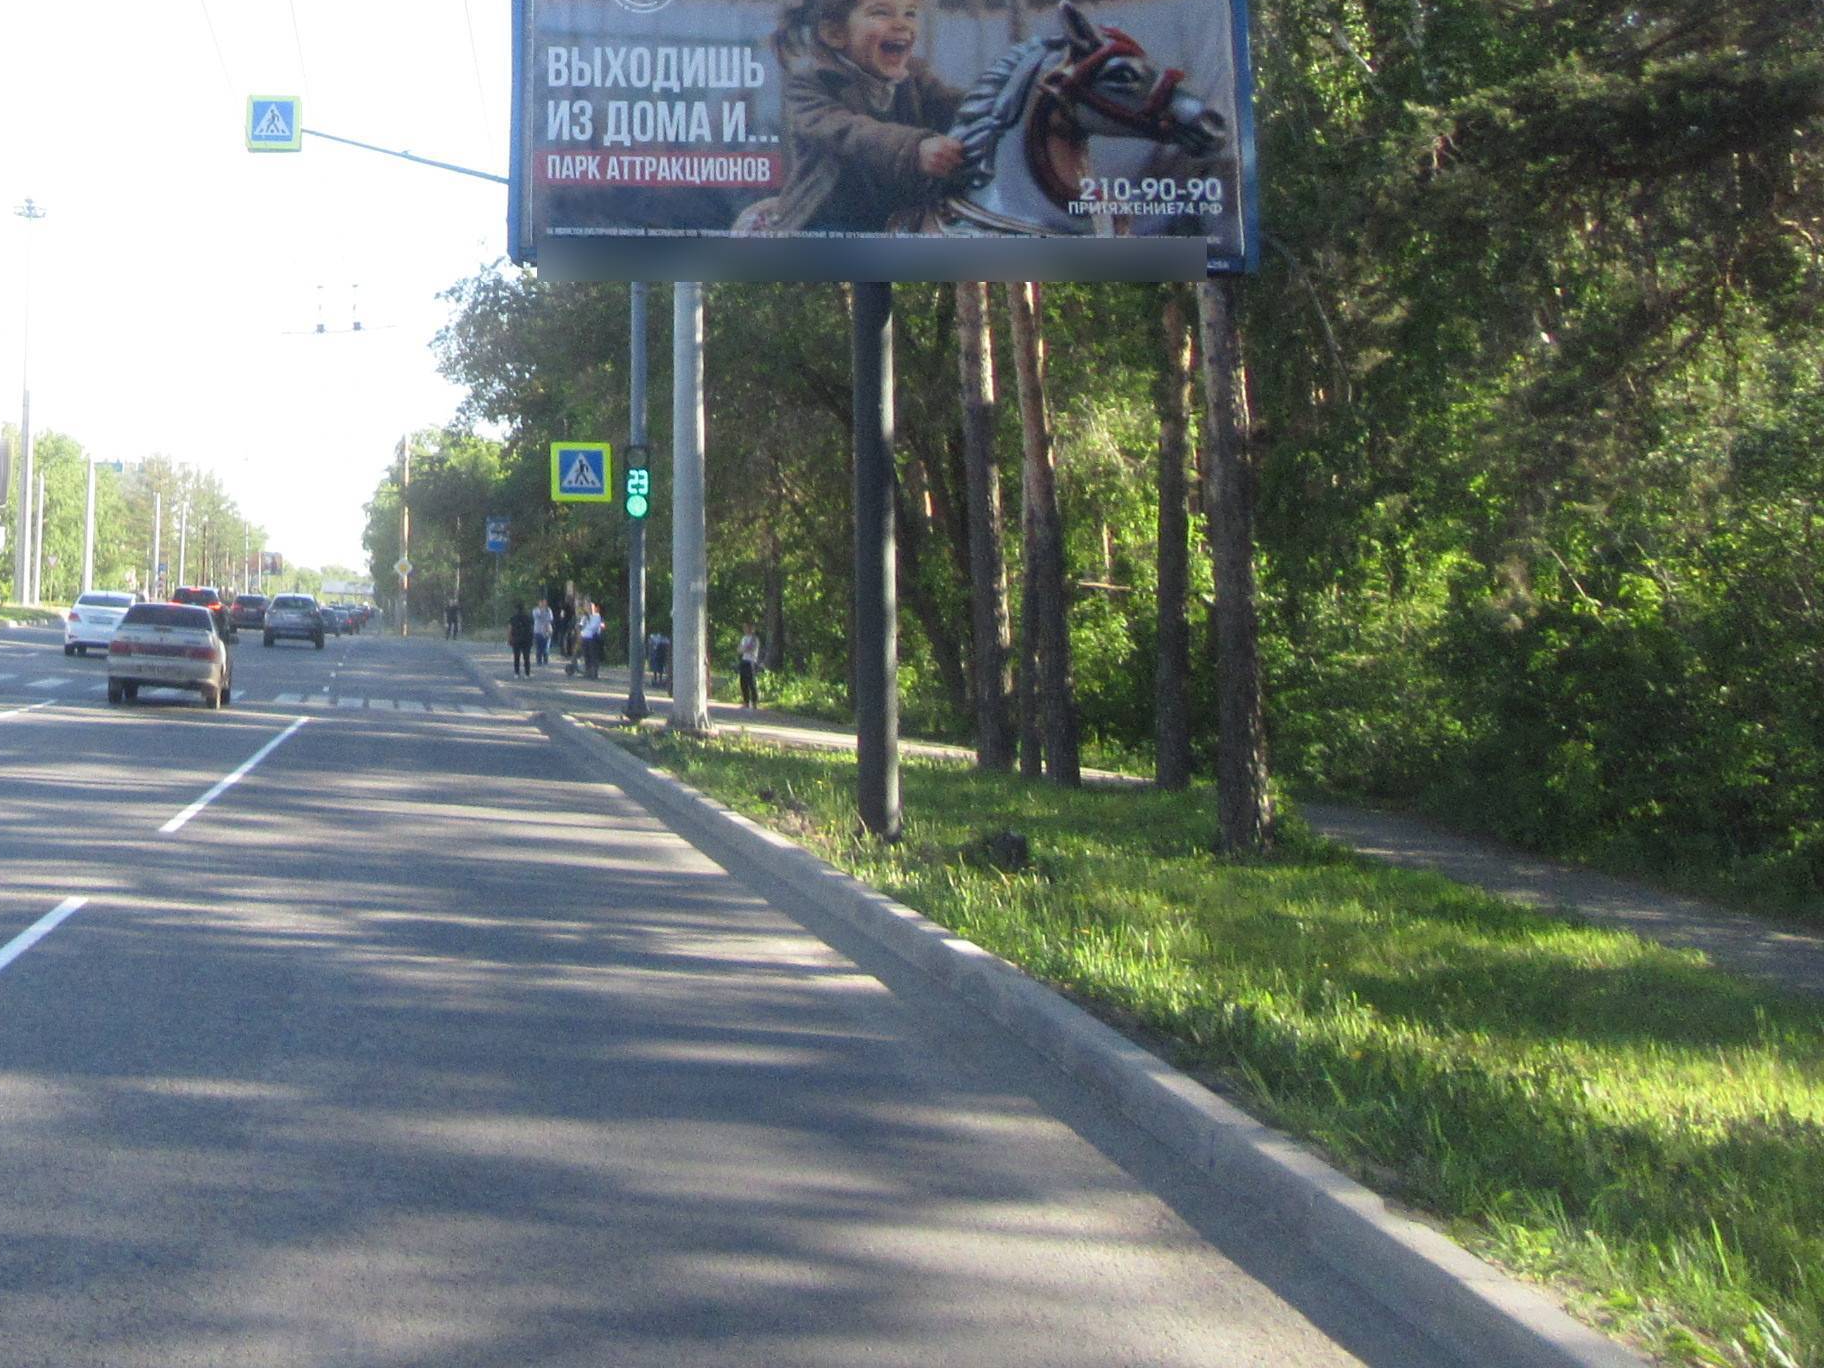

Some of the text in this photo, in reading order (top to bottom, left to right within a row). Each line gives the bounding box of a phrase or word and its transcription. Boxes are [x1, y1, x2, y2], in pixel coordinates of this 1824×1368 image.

[547, 46, 765, 92] ВЫХОДИШЬ
[547, 100, 780, 146] ИЗ ДОМА И...
[547, 155, 771, 184] ПАРК АТТРАКЦИОНОВ
[1079, 178, 1223, 201] 210-90-90
[1068, 200, 1223, 216] ПРИТЯЖЕНИЕ74.РФ
[627, 469, 649, 495] 23
